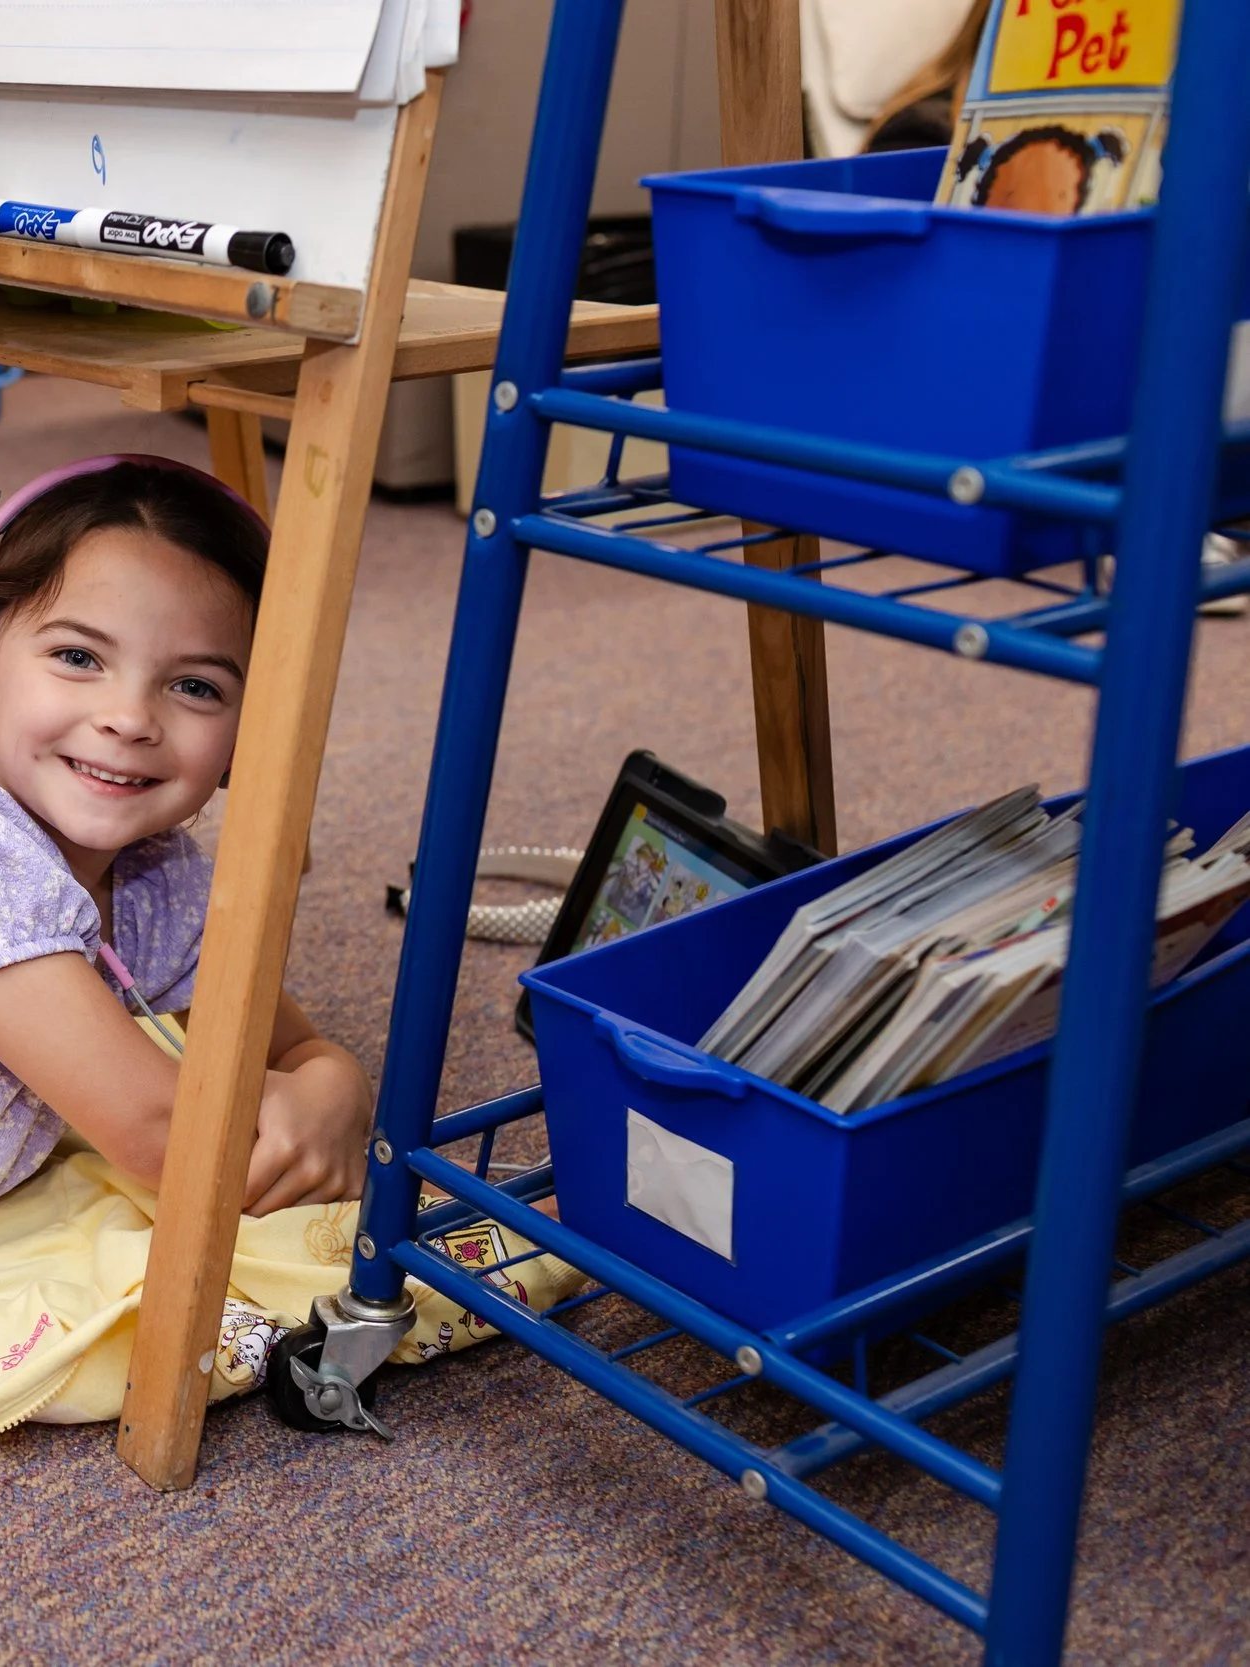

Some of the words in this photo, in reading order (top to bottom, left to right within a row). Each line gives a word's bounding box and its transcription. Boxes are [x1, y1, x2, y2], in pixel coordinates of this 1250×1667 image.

[1046, 10, 1131, 80] Pet
[14, 210, 61, 241] EXPO
[107, 229, 124, 240] odor
[124, 231, 138, 242] low
[142, 221, 206, 250] EXPO
